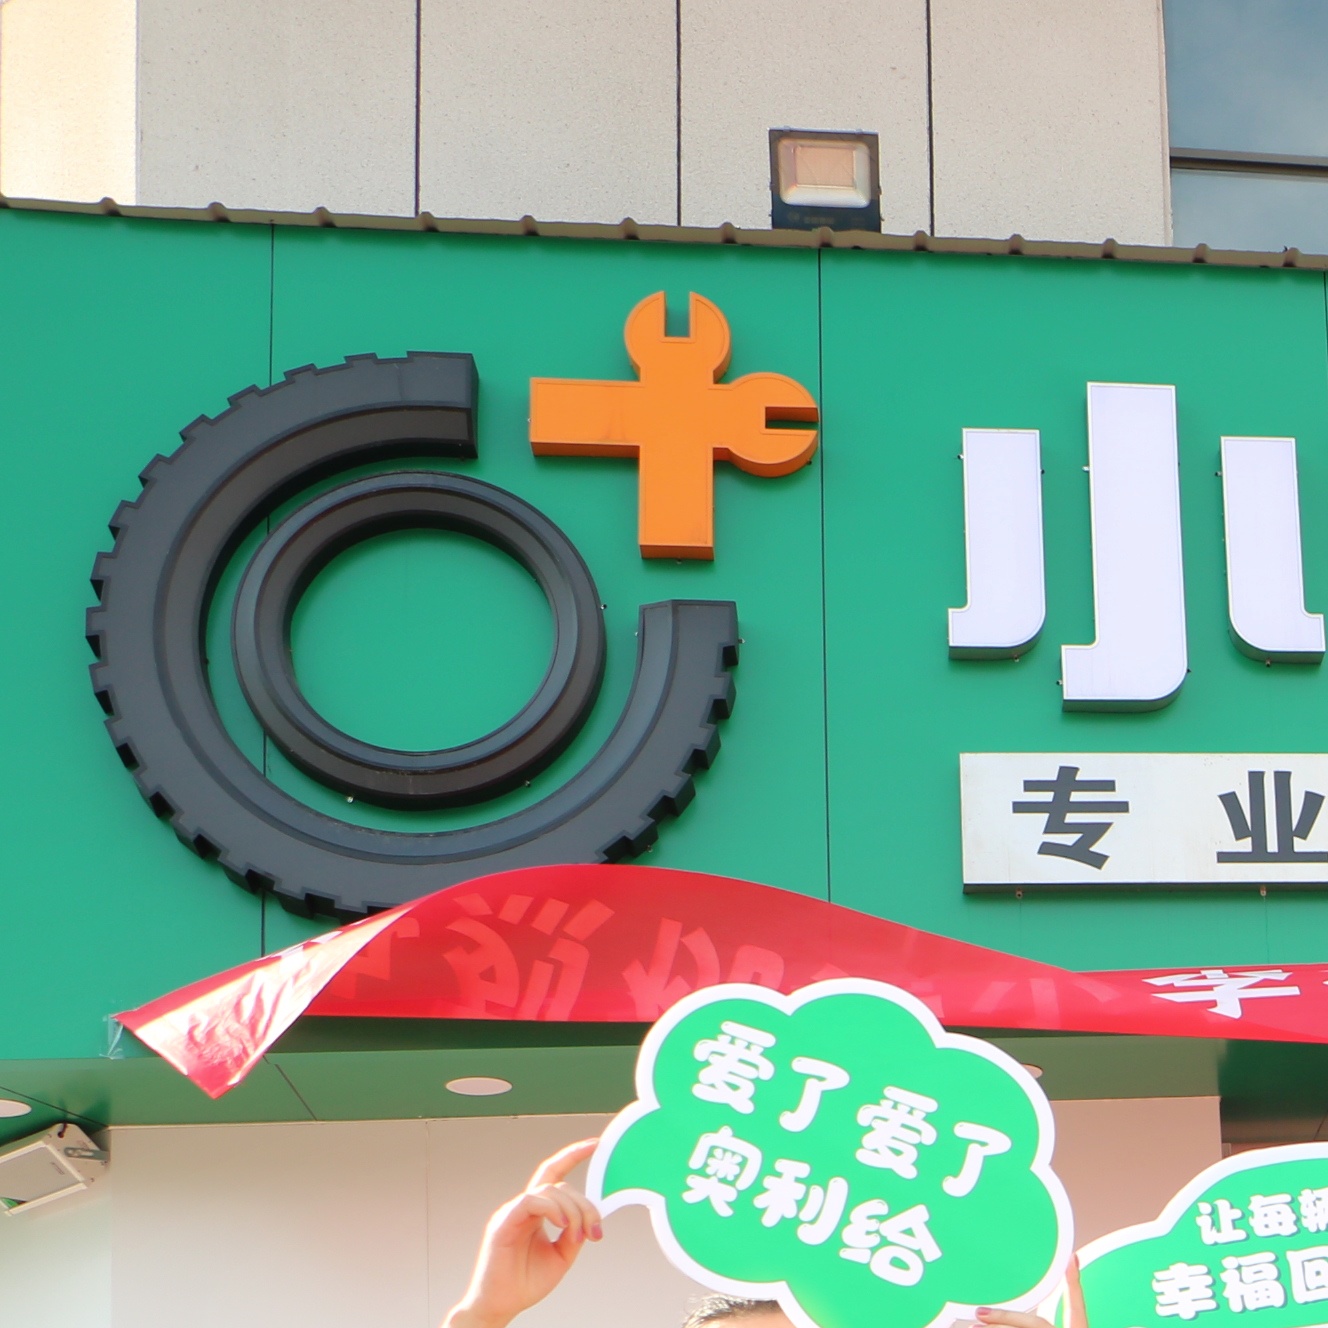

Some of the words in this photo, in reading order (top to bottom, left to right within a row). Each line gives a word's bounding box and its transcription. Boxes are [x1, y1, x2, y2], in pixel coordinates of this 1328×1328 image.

[691, 1019, 1013, 1199] 爱了爱了
[680, 1124, 944, 1289] 奥利给
